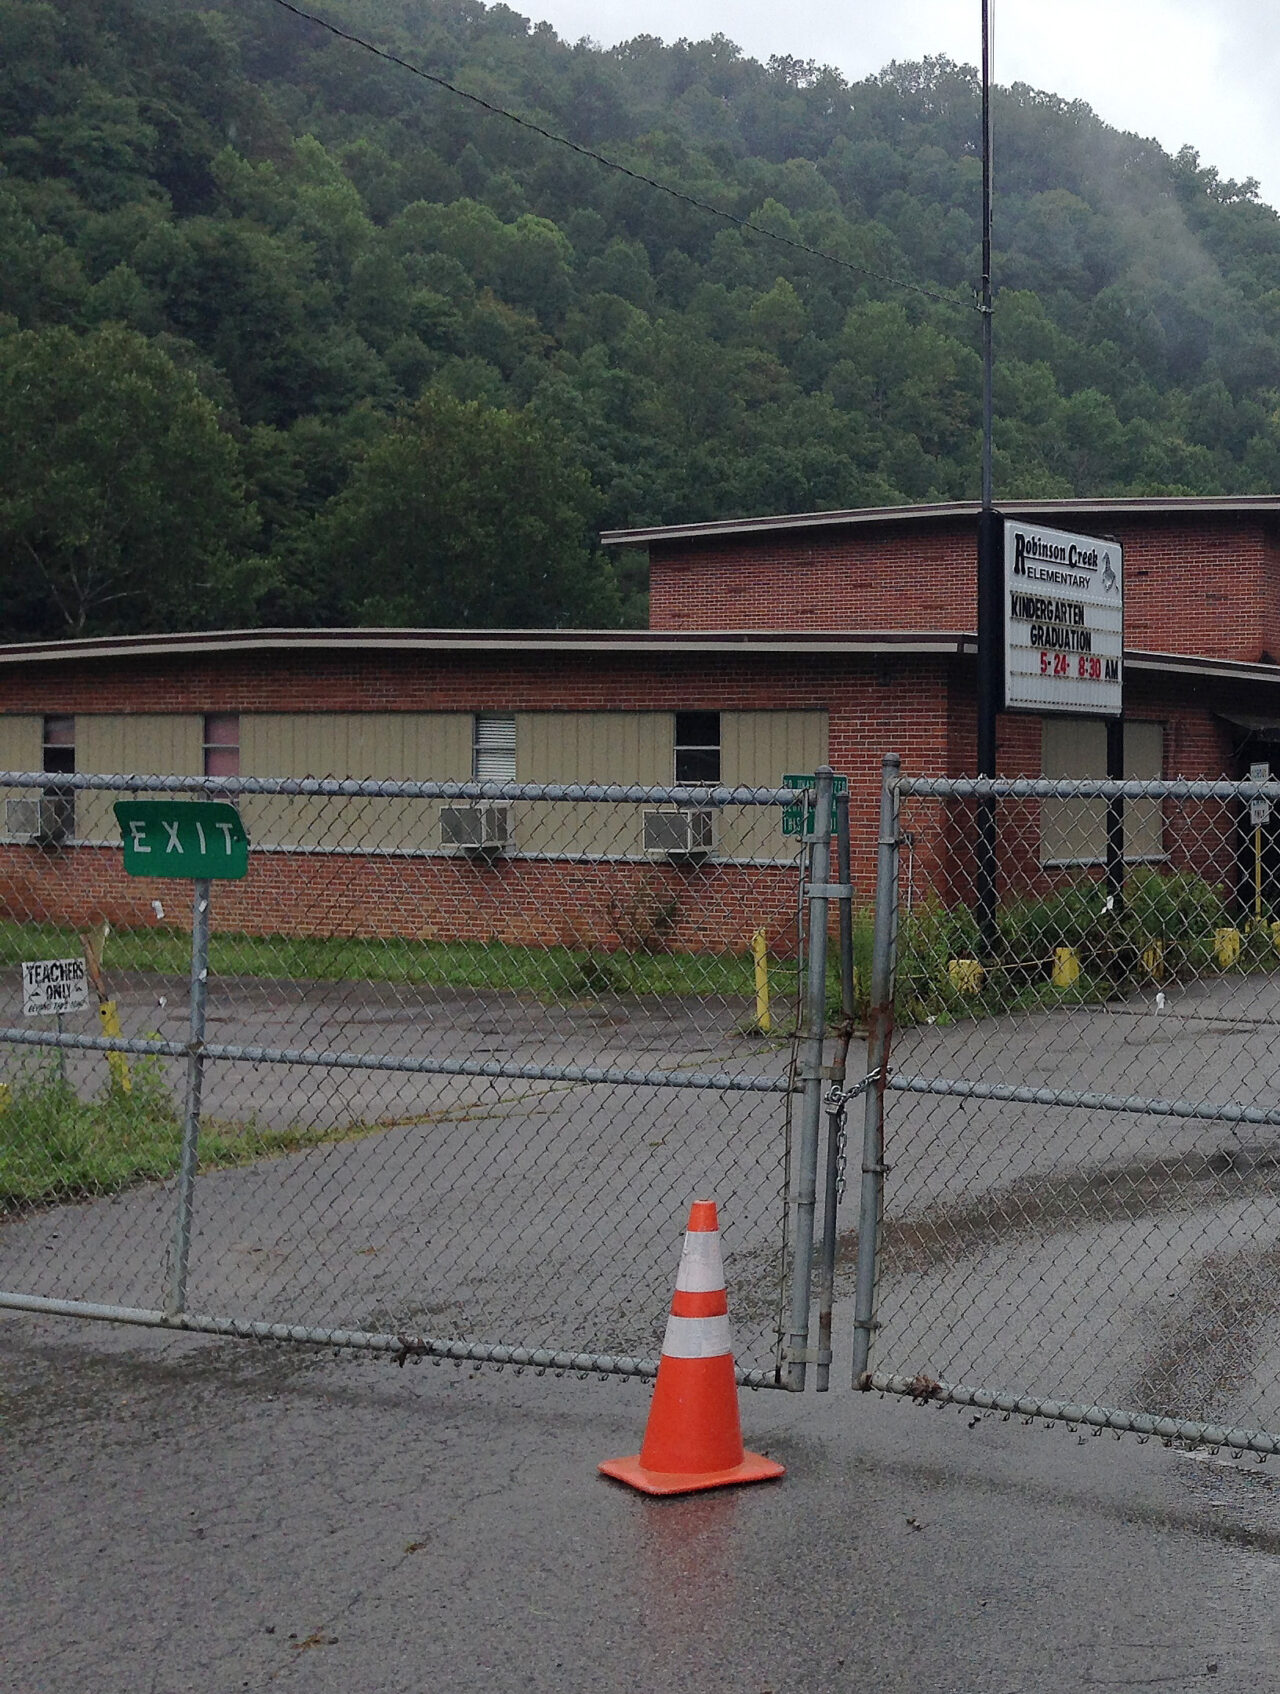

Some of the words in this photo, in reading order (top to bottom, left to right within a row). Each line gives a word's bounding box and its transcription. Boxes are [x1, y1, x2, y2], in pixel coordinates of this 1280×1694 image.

[1014, 533, 1066, 576] Robinson
[1069, 544, 1098, 569] Creek
[1027, 566, 1090, 589] ELEMENTARY
[1011, 595, 1085, 626] KINDERGARTEN
[1030, 625, 1091, 652] GRADUATION
[1078, 657, 1101, 679] 8:30
[1105, 660, 1118, 680] AM
[129, 820, 233, 855] EXIT
[26, 961, 84, 985] TEACHERS
[46, 983, 71, 1000] ONLY
